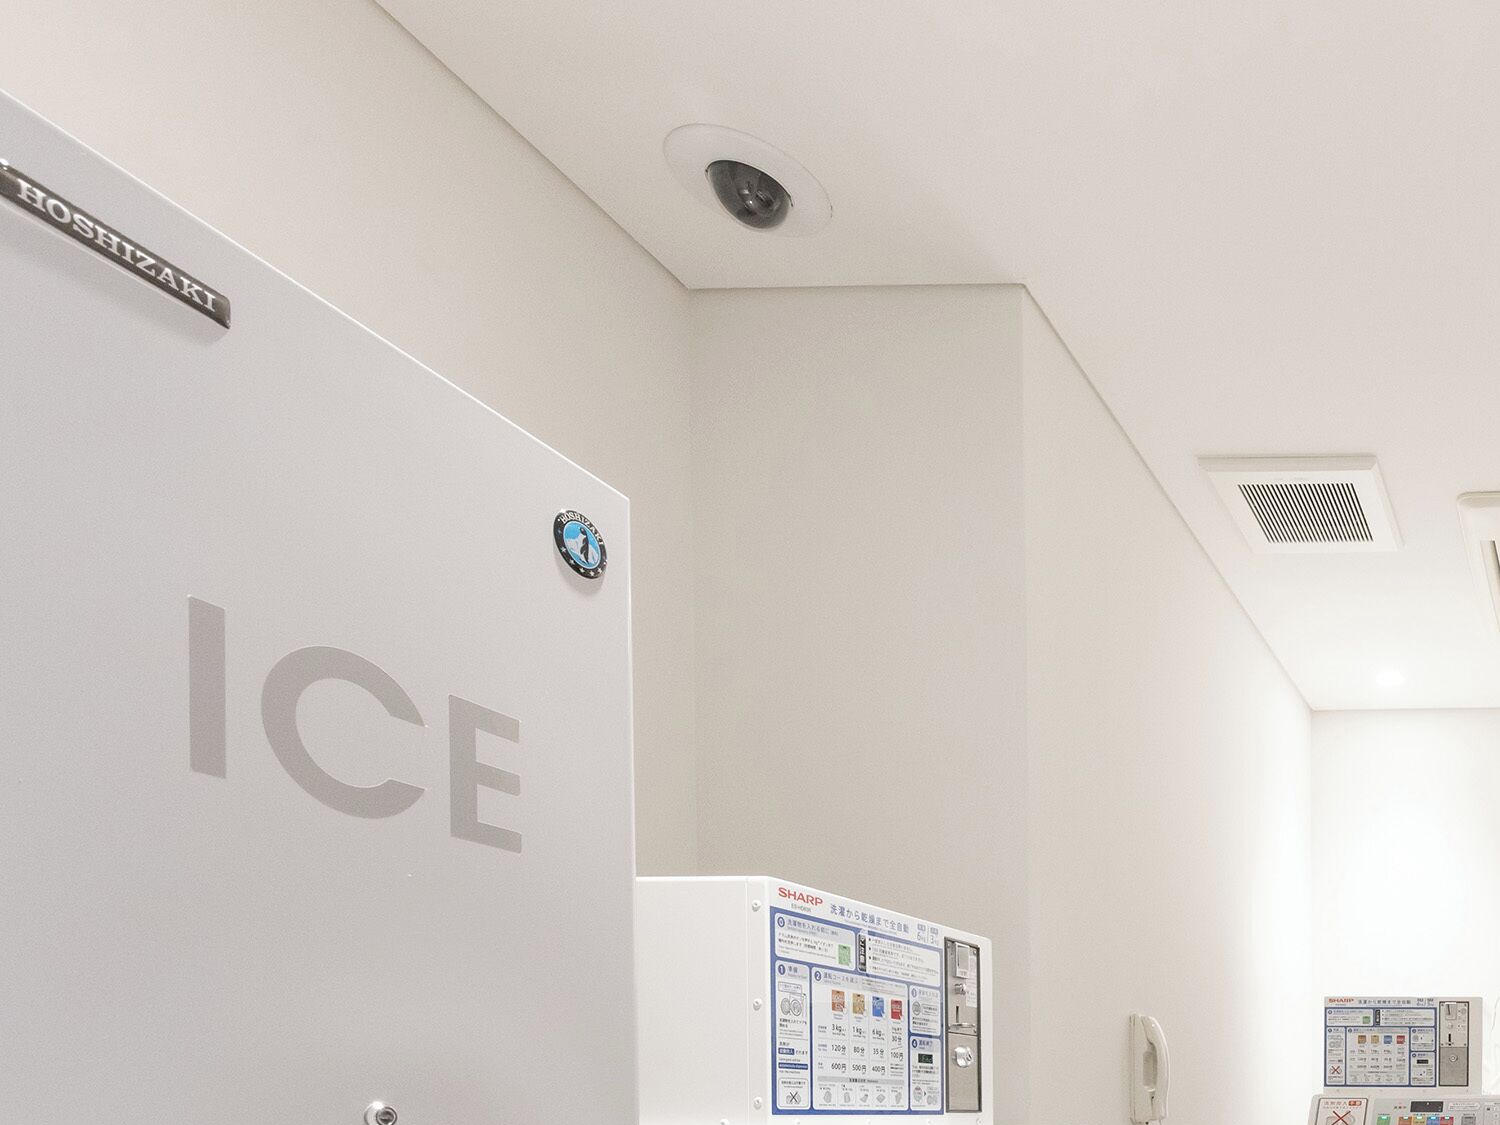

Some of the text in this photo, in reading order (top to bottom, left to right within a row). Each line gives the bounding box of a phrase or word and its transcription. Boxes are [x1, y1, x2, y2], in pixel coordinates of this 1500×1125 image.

[17, 178, 216, 313] HOSHIZAKI
[188, 594, 523, 855] ICE
[778, 887, 823, 906] SHARP
[830, 903, 910, 933] 洗濯から乾燥まで全自動
